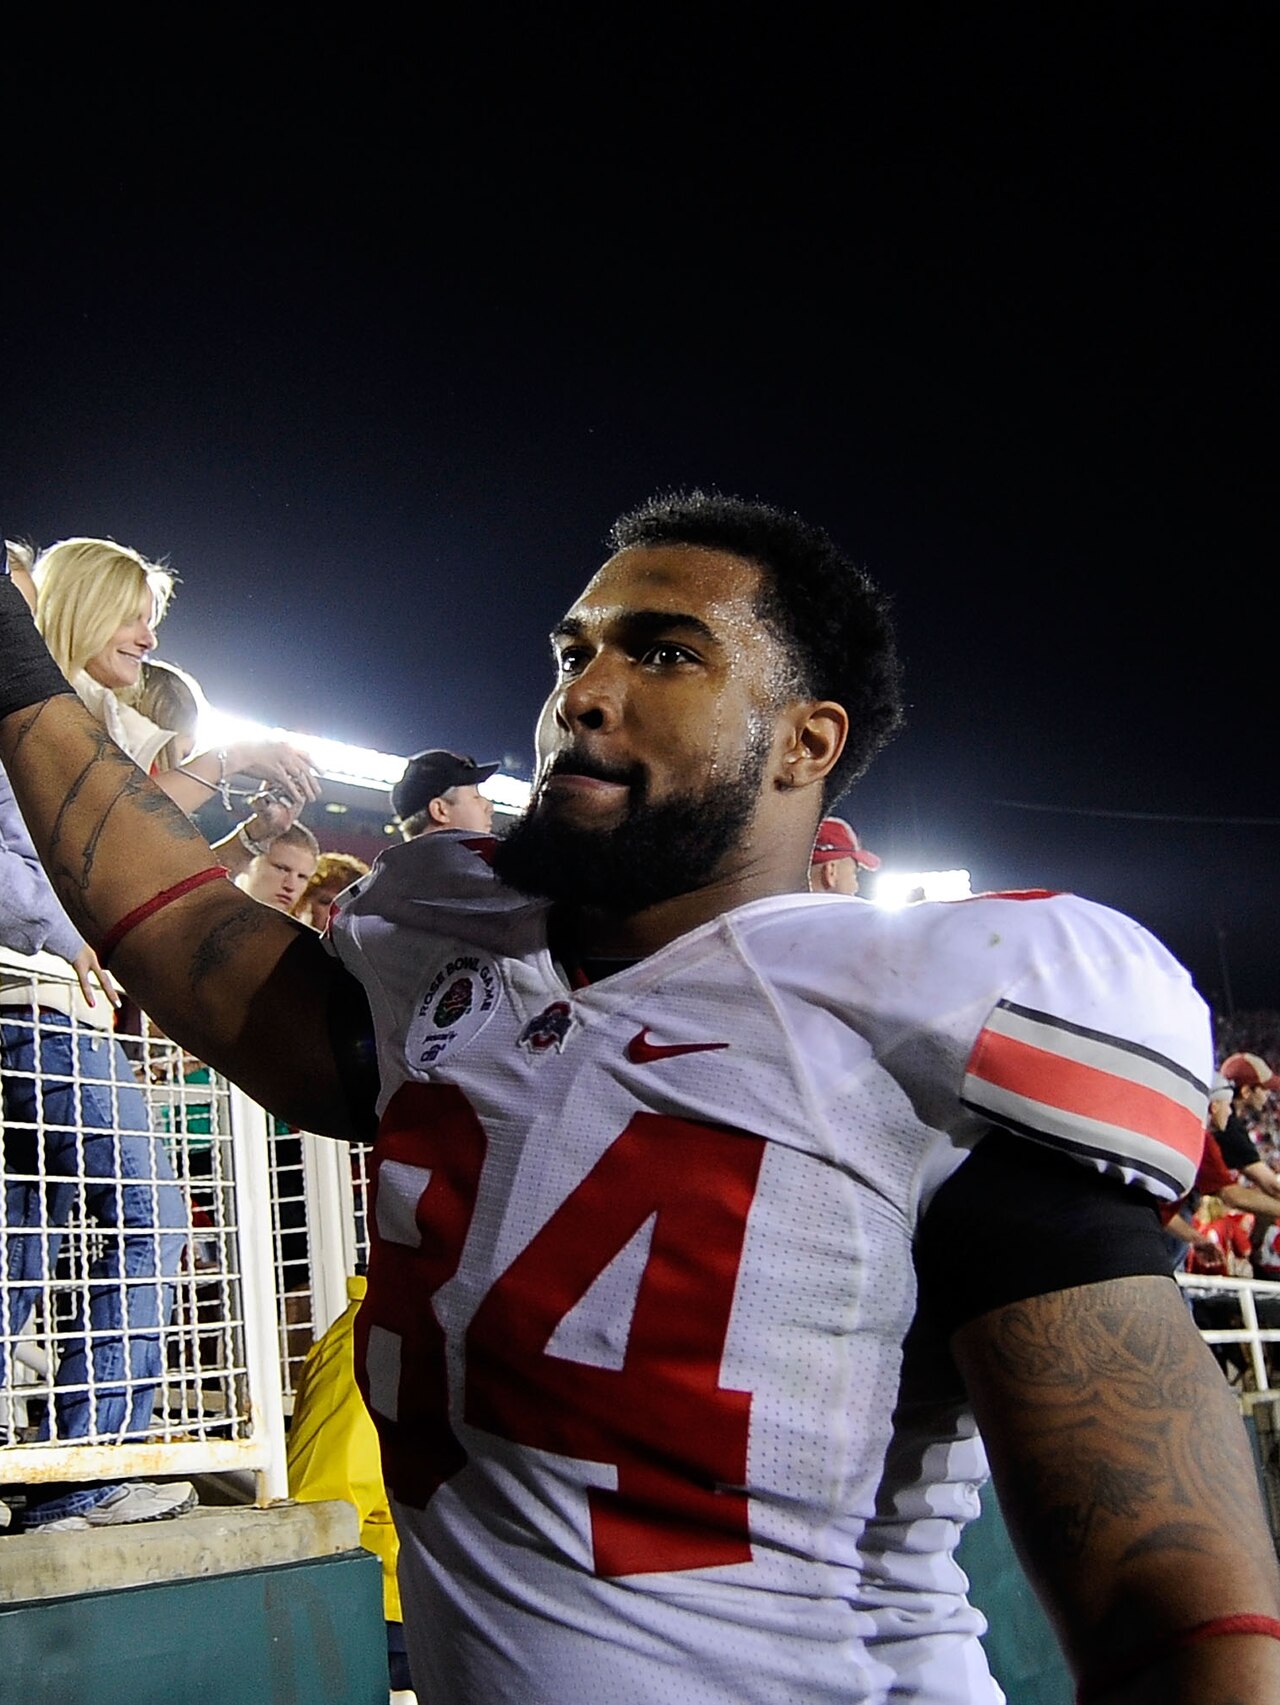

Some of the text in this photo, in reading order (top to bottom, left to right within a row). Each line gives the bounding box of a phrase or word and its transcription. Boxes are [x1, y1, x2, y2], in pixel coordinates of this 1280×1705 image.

[418, 956, 496, 1018] ROSE BOWL GAME
[353, 1080, 767, 1577] 84
